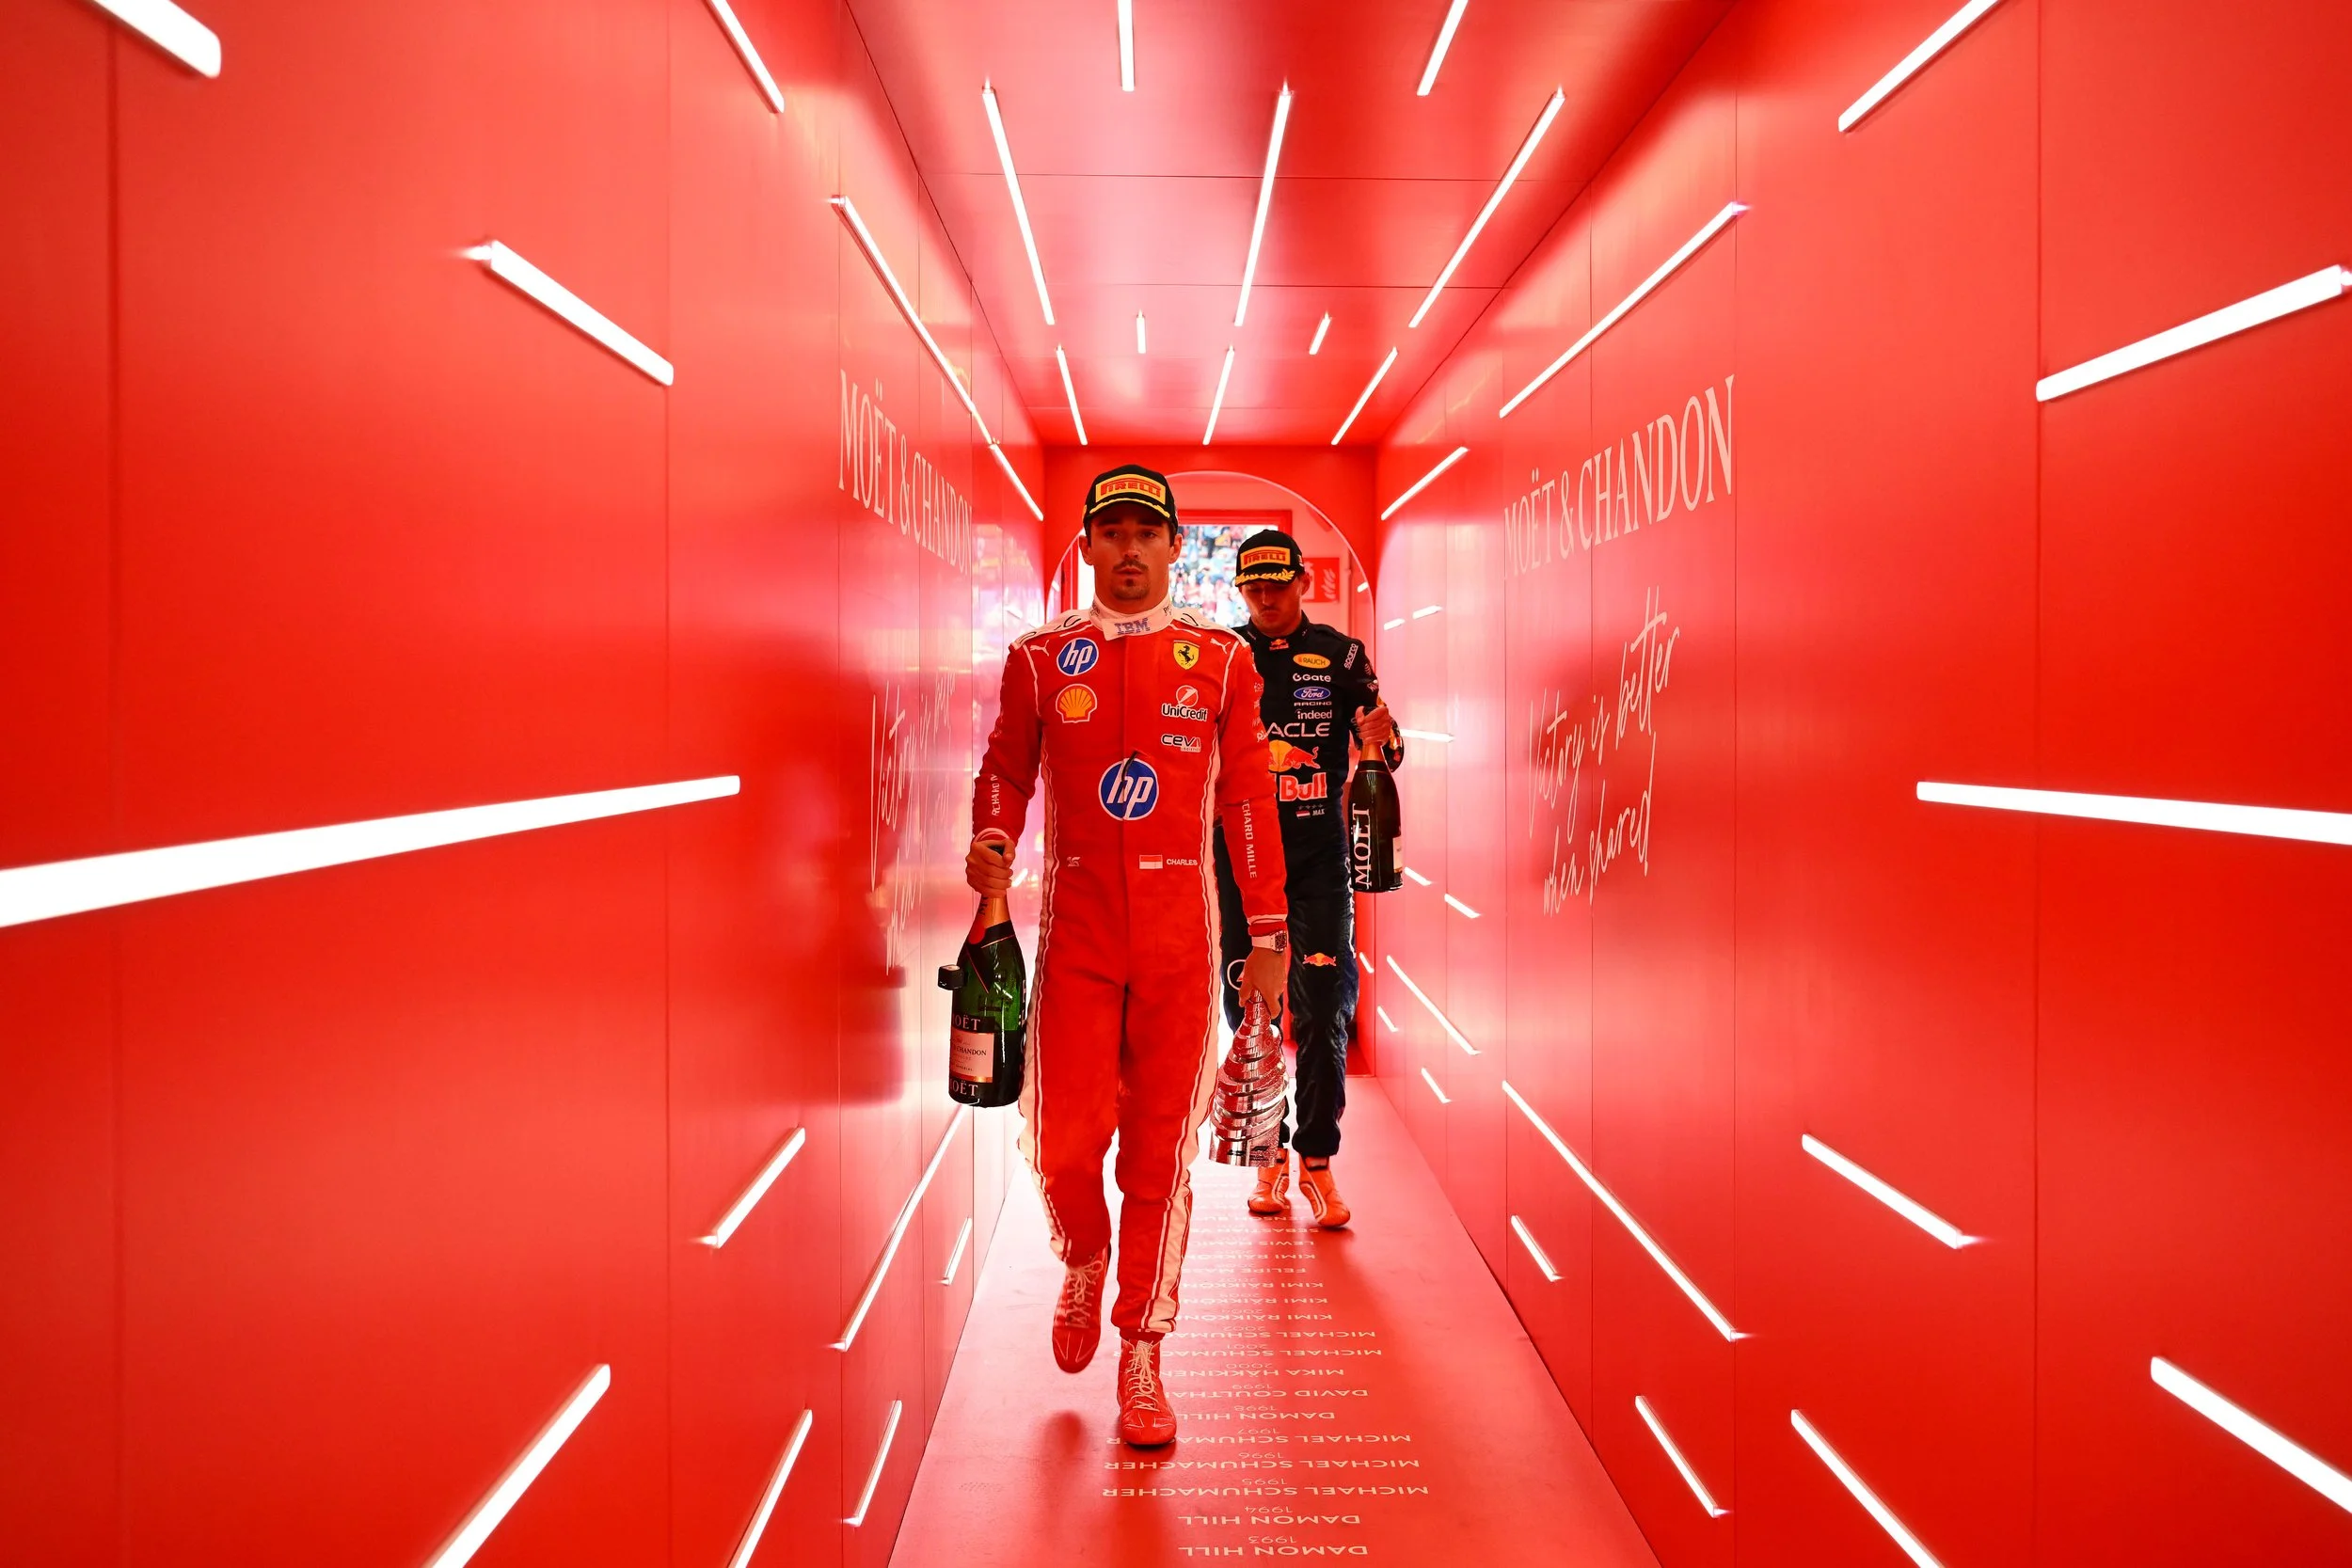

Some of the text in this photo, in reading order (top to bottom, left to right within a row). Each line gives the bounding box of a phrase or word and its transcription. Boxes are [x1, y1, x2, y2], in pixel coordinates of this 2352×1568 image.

[838, 369, 972, 576] MOËT & CHANDON
[1503, 374, 1735, 580] MOËT & CHANDON
[1100, 478, 1161, 498] PIRELLI
[1243, 550, 1286, 564] PIRELLI
[1114, 617, 1151, 636] IBM
[1061, 639, 1095, 675] hp
[1303, 657, 1327, 666] RAUCH
[1343, 642, 1359, 670] sparco
[1300, 688, 1325, 699] Ford
[1162, 703, 1207, 721] UniCredit
[1297, 709, 1332, 720] indeed
[1528, 585, 1679, 845] Victory is better
[1266, 721, 1330, 737] ACLE
[1104, 759, 1155, 819] hp
[1279, 772, 1327, 801] Bull
[1543, 731, 1657, 917] when shared
[1166, 858, 1198, 866] CHARLES
[1246, 844, 1258, 879] MILLE
[952, 1014, 981, 1031] OËT
[951, 1080, 978, 1097] OËT
[1164, 1389, 1286, 1399] COULTHA
[1295, 1434, 1411, 1443] MICHAEL
[1104, 1459, 1420, 1470] MICHAEL SCHUMACHER
[1102, 1485, 1429, 1497] MICHAEL SCHUMACHER
[1245, 1506, 1294, 1514] 1994
[1178, 1514, 1361, 1526] DAMON HILL
[1248, 1535, 1297, 1544] 1993
[1178, 1544, 1368, 1557] DAMON HILL
